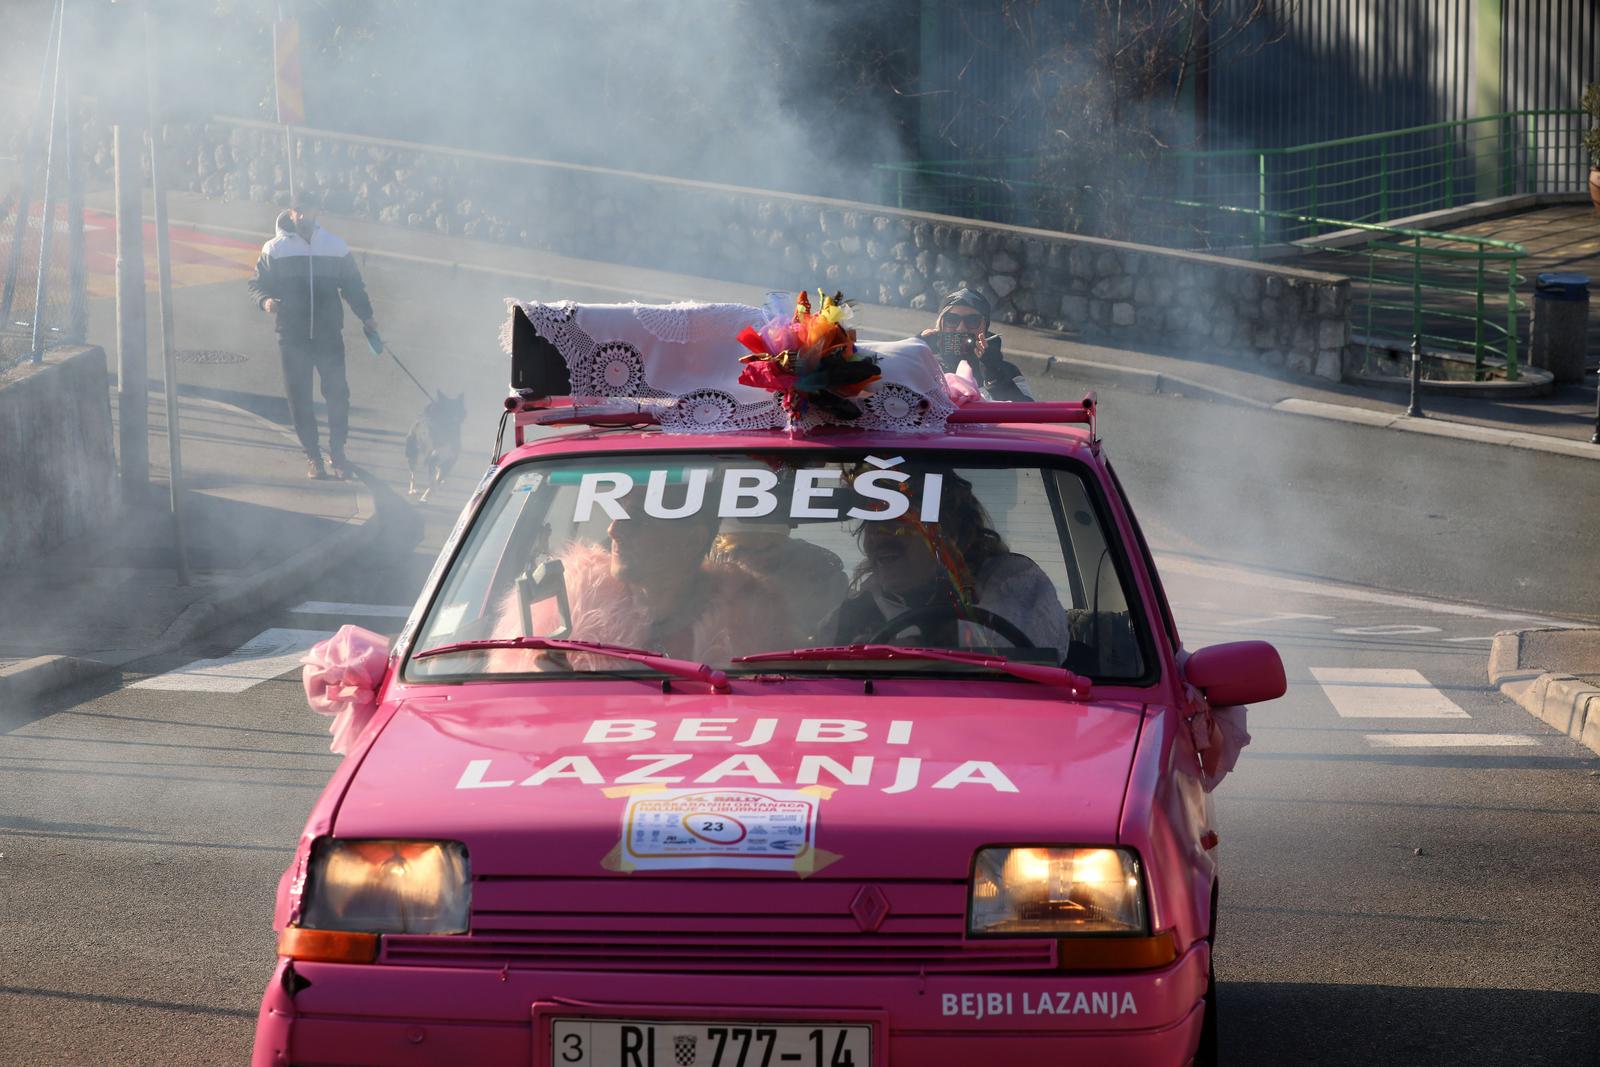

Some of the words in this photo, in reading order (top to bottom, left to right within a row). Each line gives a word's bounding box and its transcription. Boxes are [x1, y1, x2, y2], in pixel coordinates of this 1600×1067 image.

[573, 454, 944, 523] RUBEŠI
[581, 717, 914, 747] BEJBI
[455, 753, 1020, 795] LAZANJA
[702, 822, 724, 831] 23
[941, 992, 1013, 1020] BEJBI
[1022, 991, 1138, 1019] LAZANJA
[561, 1033, 584, 1063] 3
[620, 1025, 655, 1067] RI
[707, 1027, 854, 1067] 777-14
